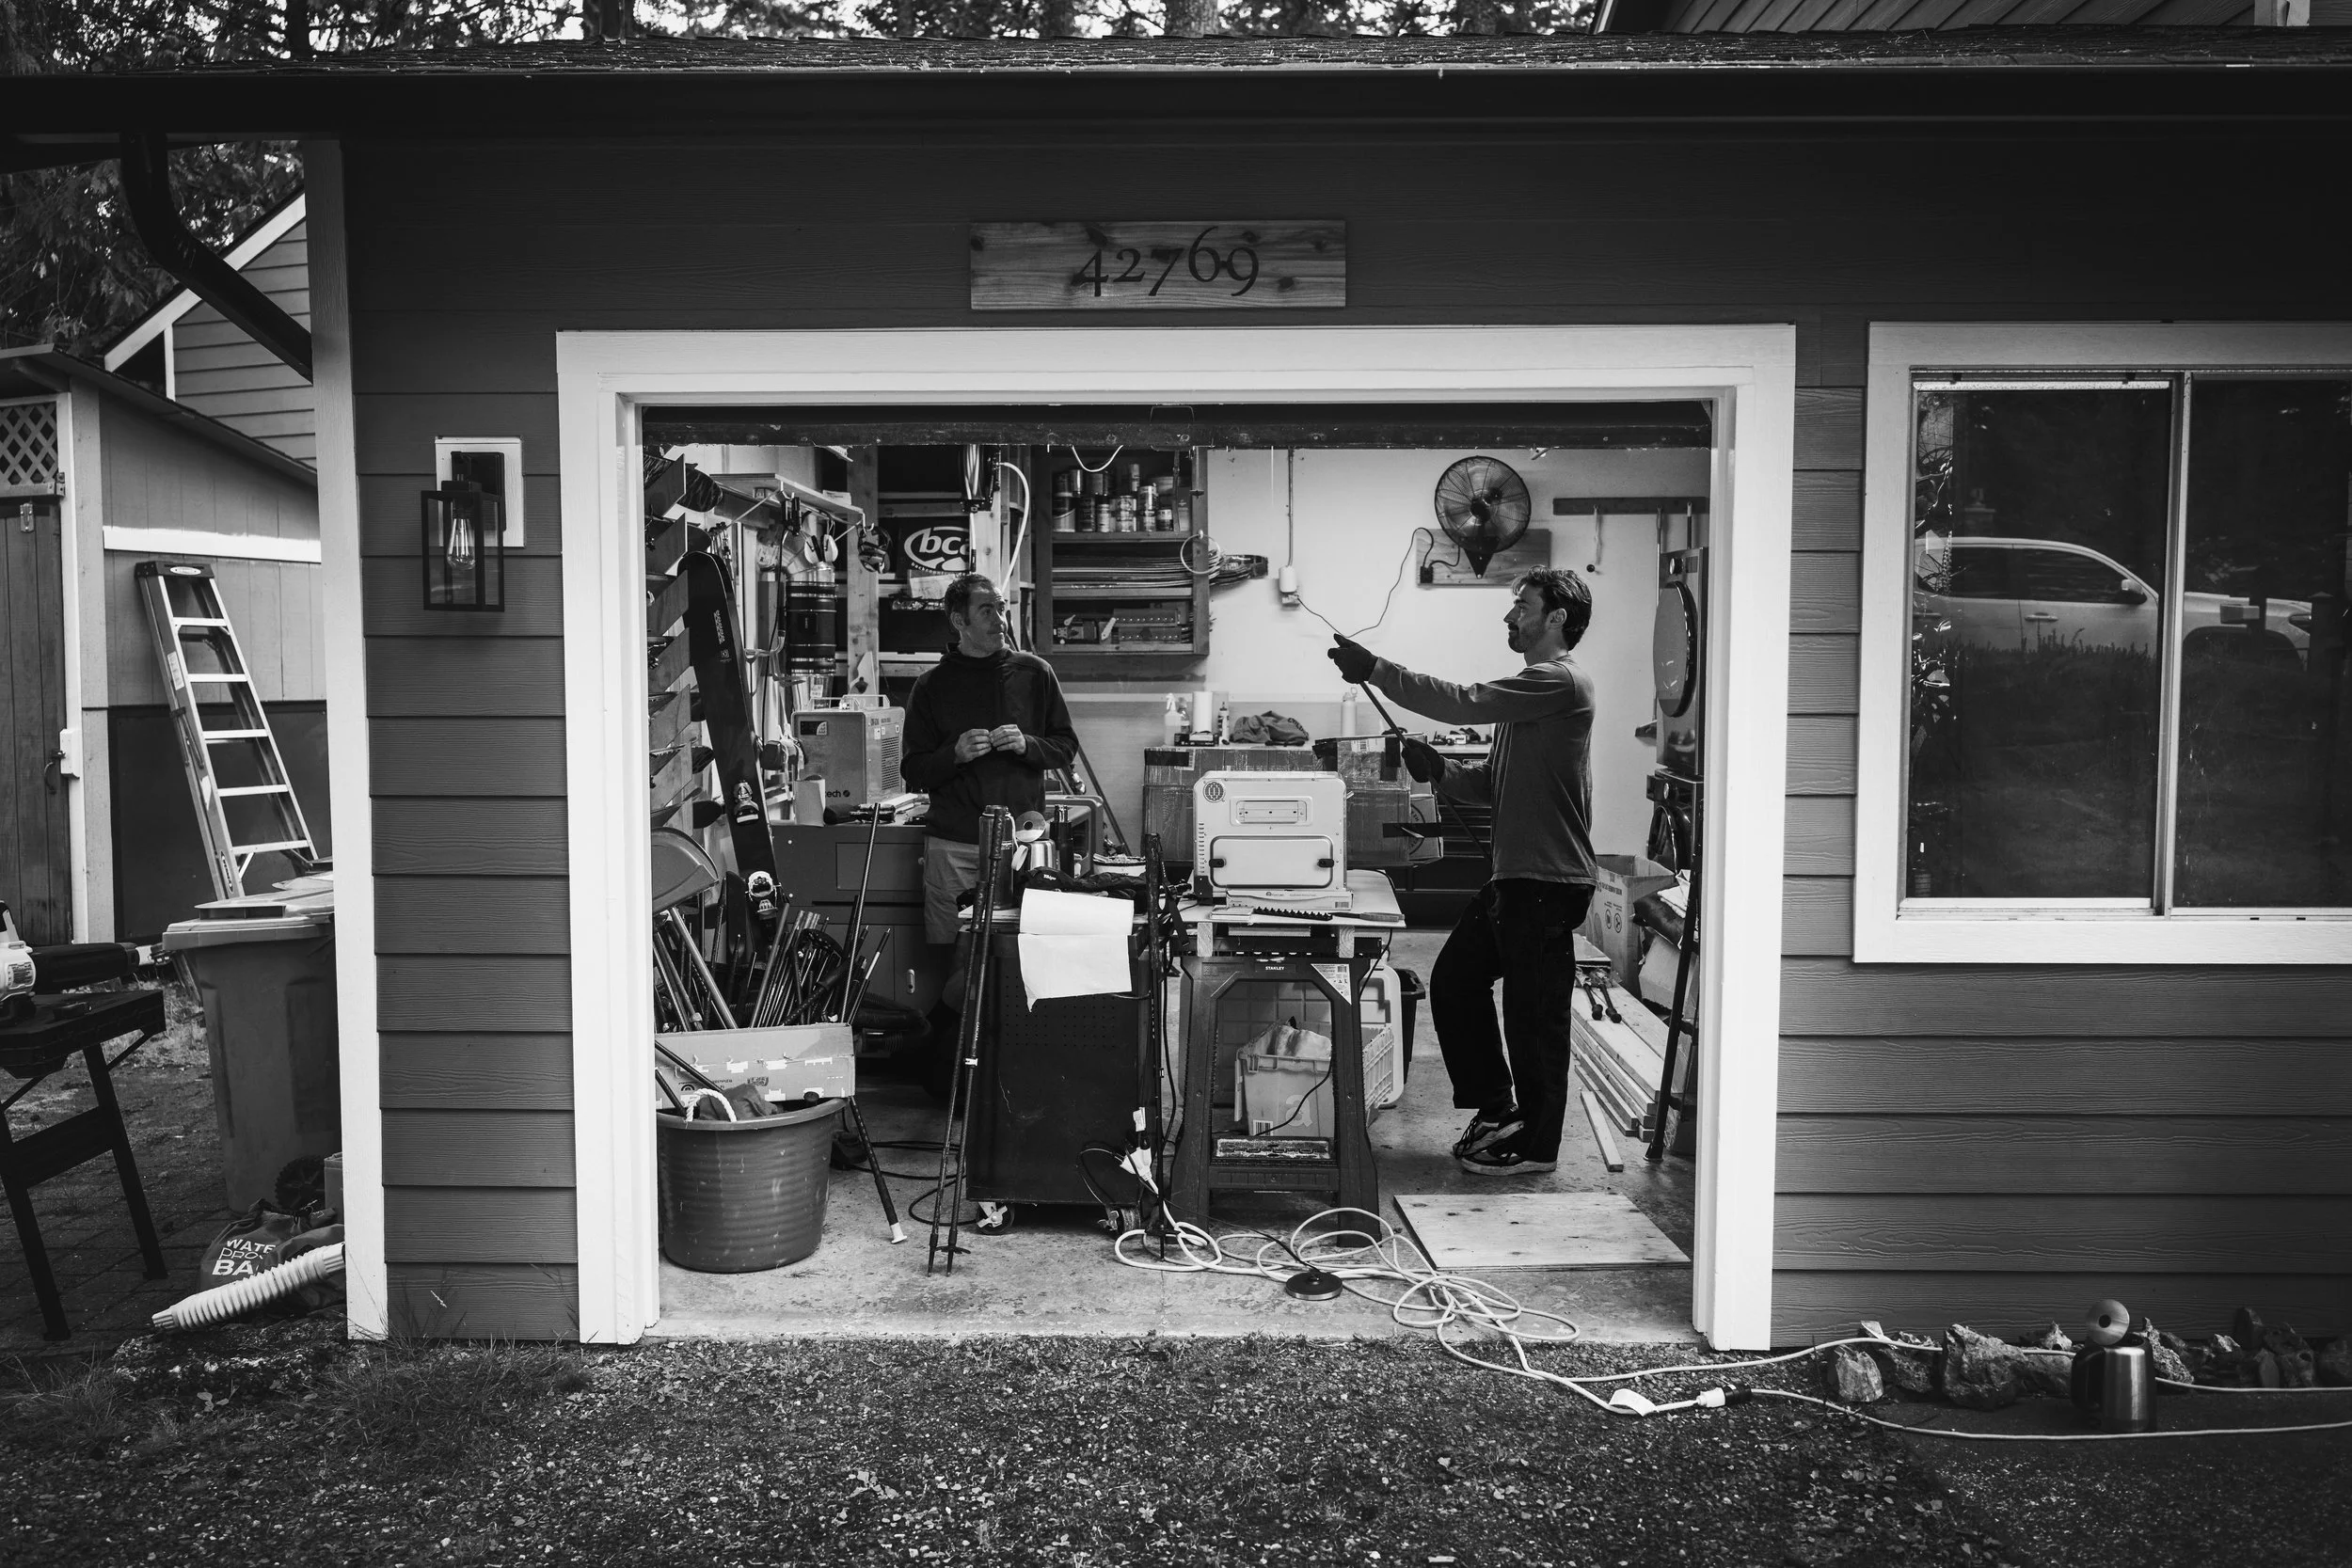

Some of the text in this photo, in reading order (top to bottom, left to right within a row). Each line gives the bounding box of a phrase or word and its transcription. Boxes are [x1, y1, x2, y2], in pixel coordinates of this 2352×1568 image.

[1073, 226, 1259, 296] 42769
[218, 1247, 263, 1259] PRO
[212, 1259, 260, 1275] BA
